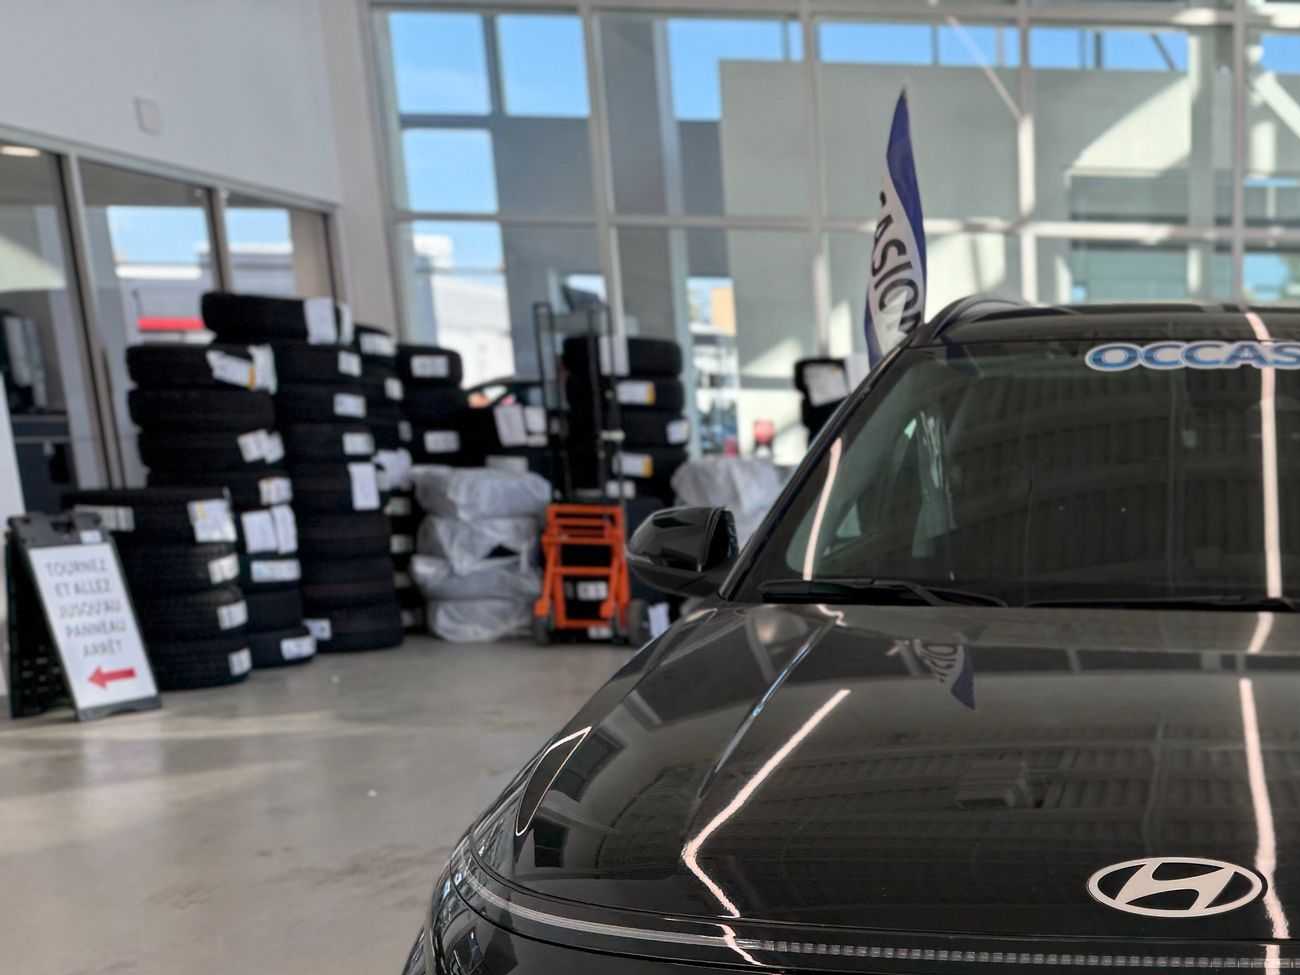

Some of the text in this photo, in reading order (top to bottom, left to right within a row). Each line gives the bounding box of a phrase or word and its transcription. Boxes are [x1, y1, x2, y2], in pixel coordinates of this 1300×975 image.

[45, 558, 107, 576] TOURNEZ
[55, 578, 112, 598] ET ALLEZ
